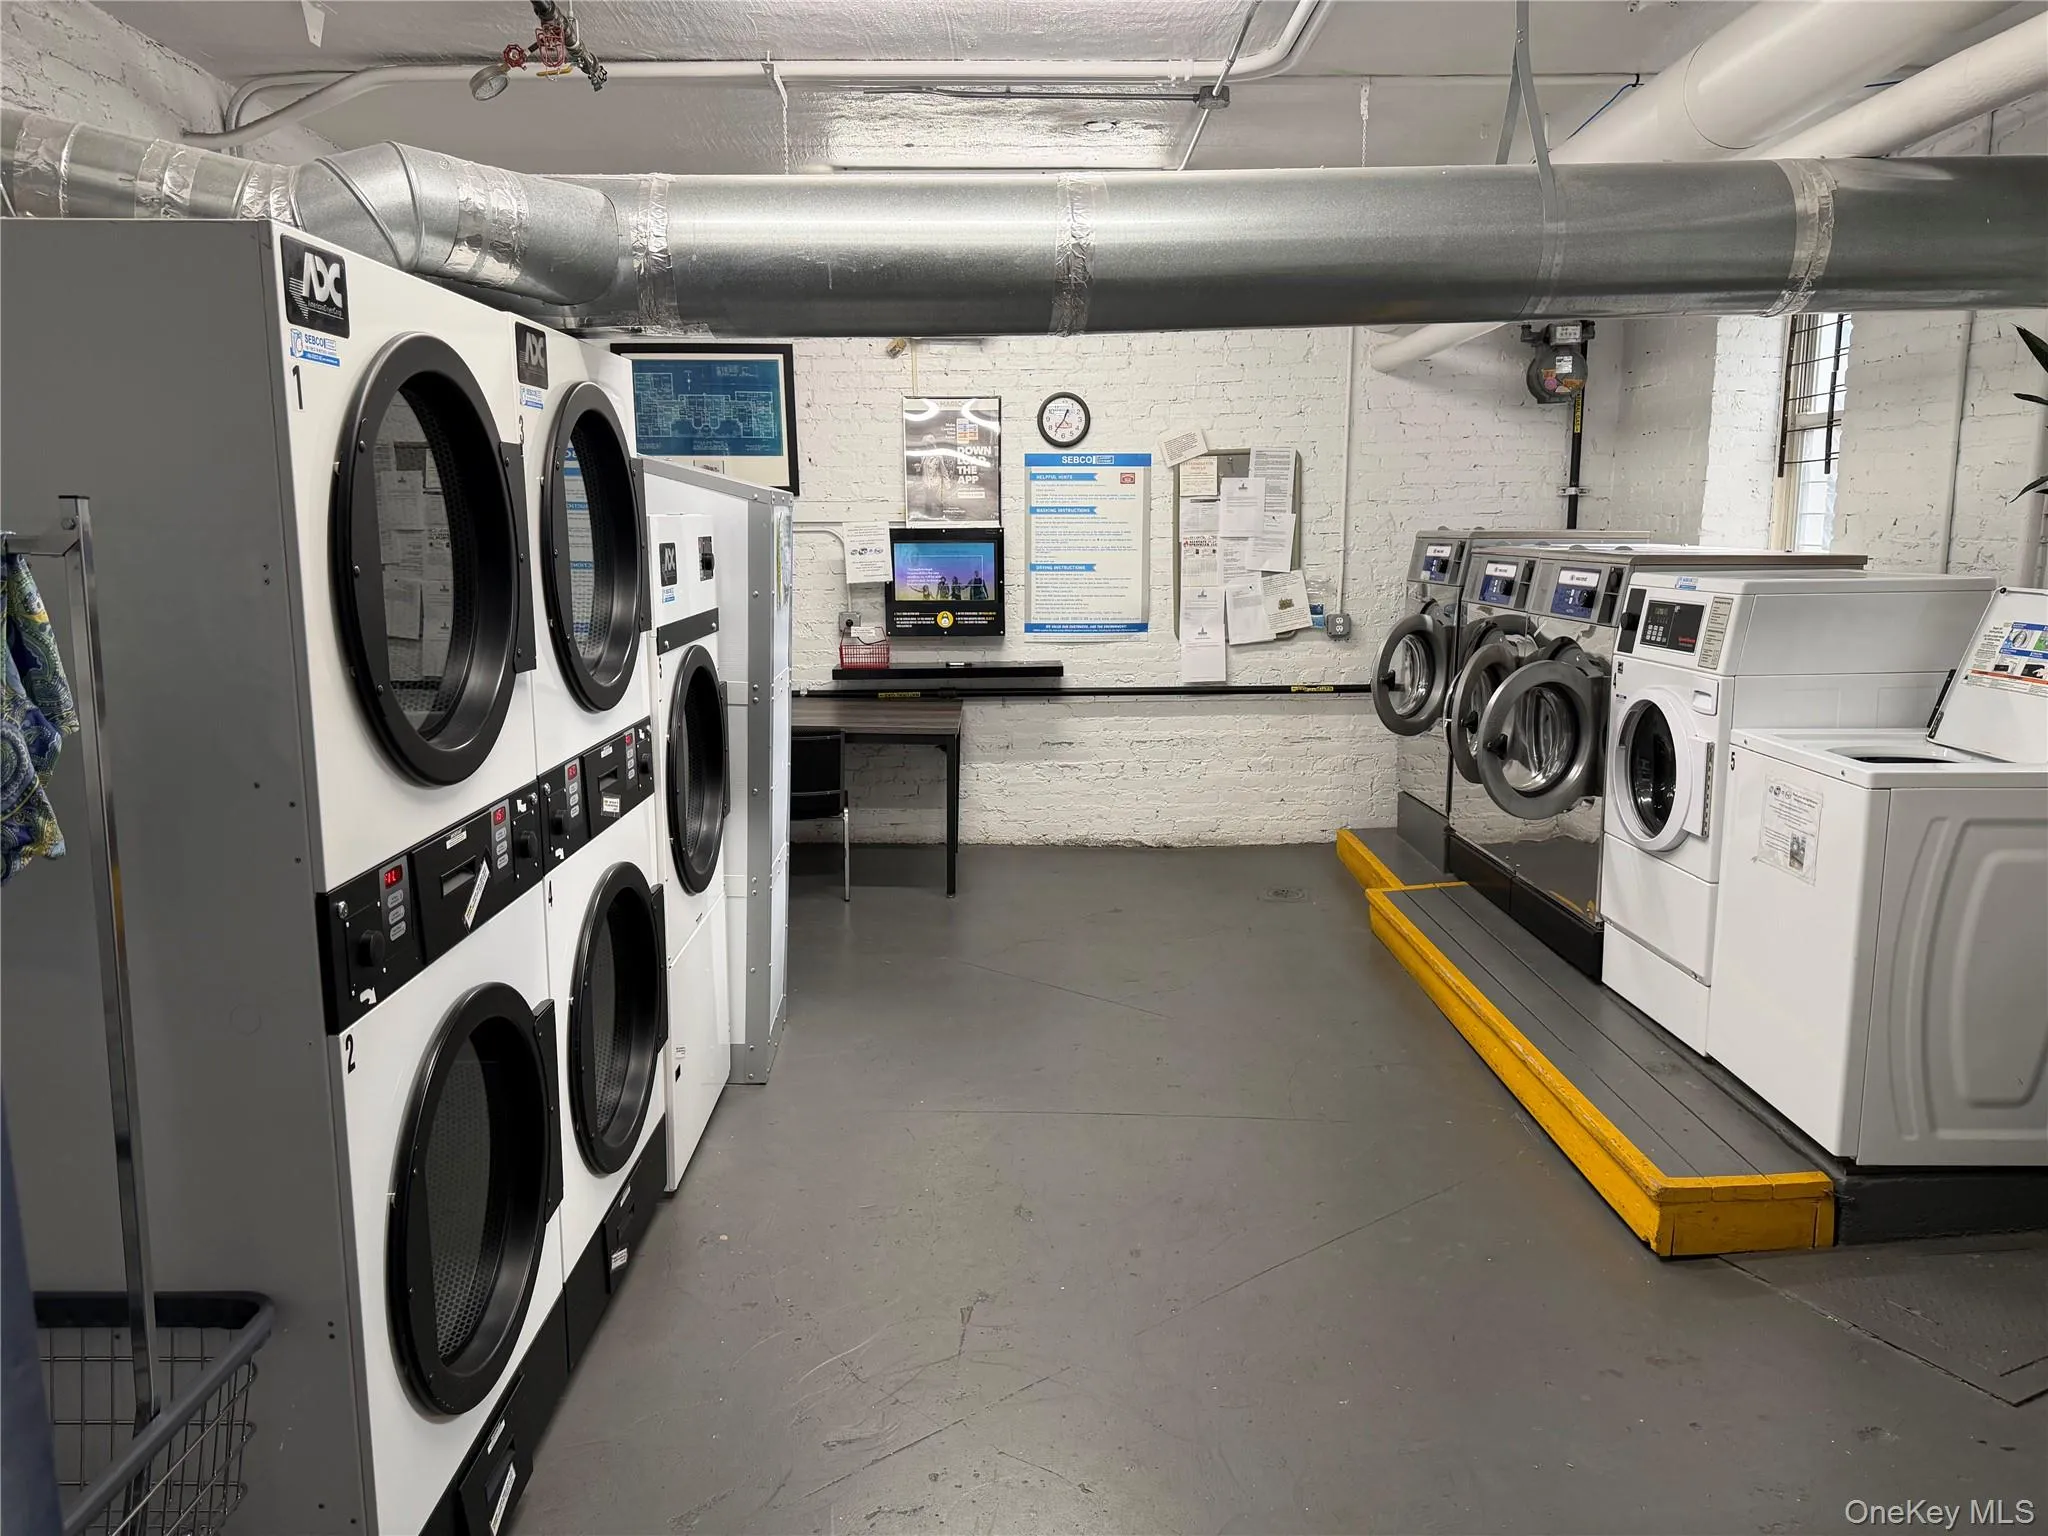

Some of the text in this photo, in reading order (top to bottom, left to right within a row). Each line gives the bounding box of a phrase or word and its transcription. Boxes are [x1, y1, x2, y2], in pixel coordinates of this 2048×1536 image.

[302, 251, 343, 309] ADC
[304, 333, 325, 348] SEBCO
[525, 331, 545, 369] ADC
[292, 364, 303, 410] 1
[519, 414, 524, 444] 3
[957, 446, 992, 455] DOWN
[1061, 456, 1093, 464] SEBCO
[956, 465, 978, 475] THE
[957, 475, 979, 484] APP
[1730, 751, 1736, 771] 5
[345, 1033, 356, 1074] 2
